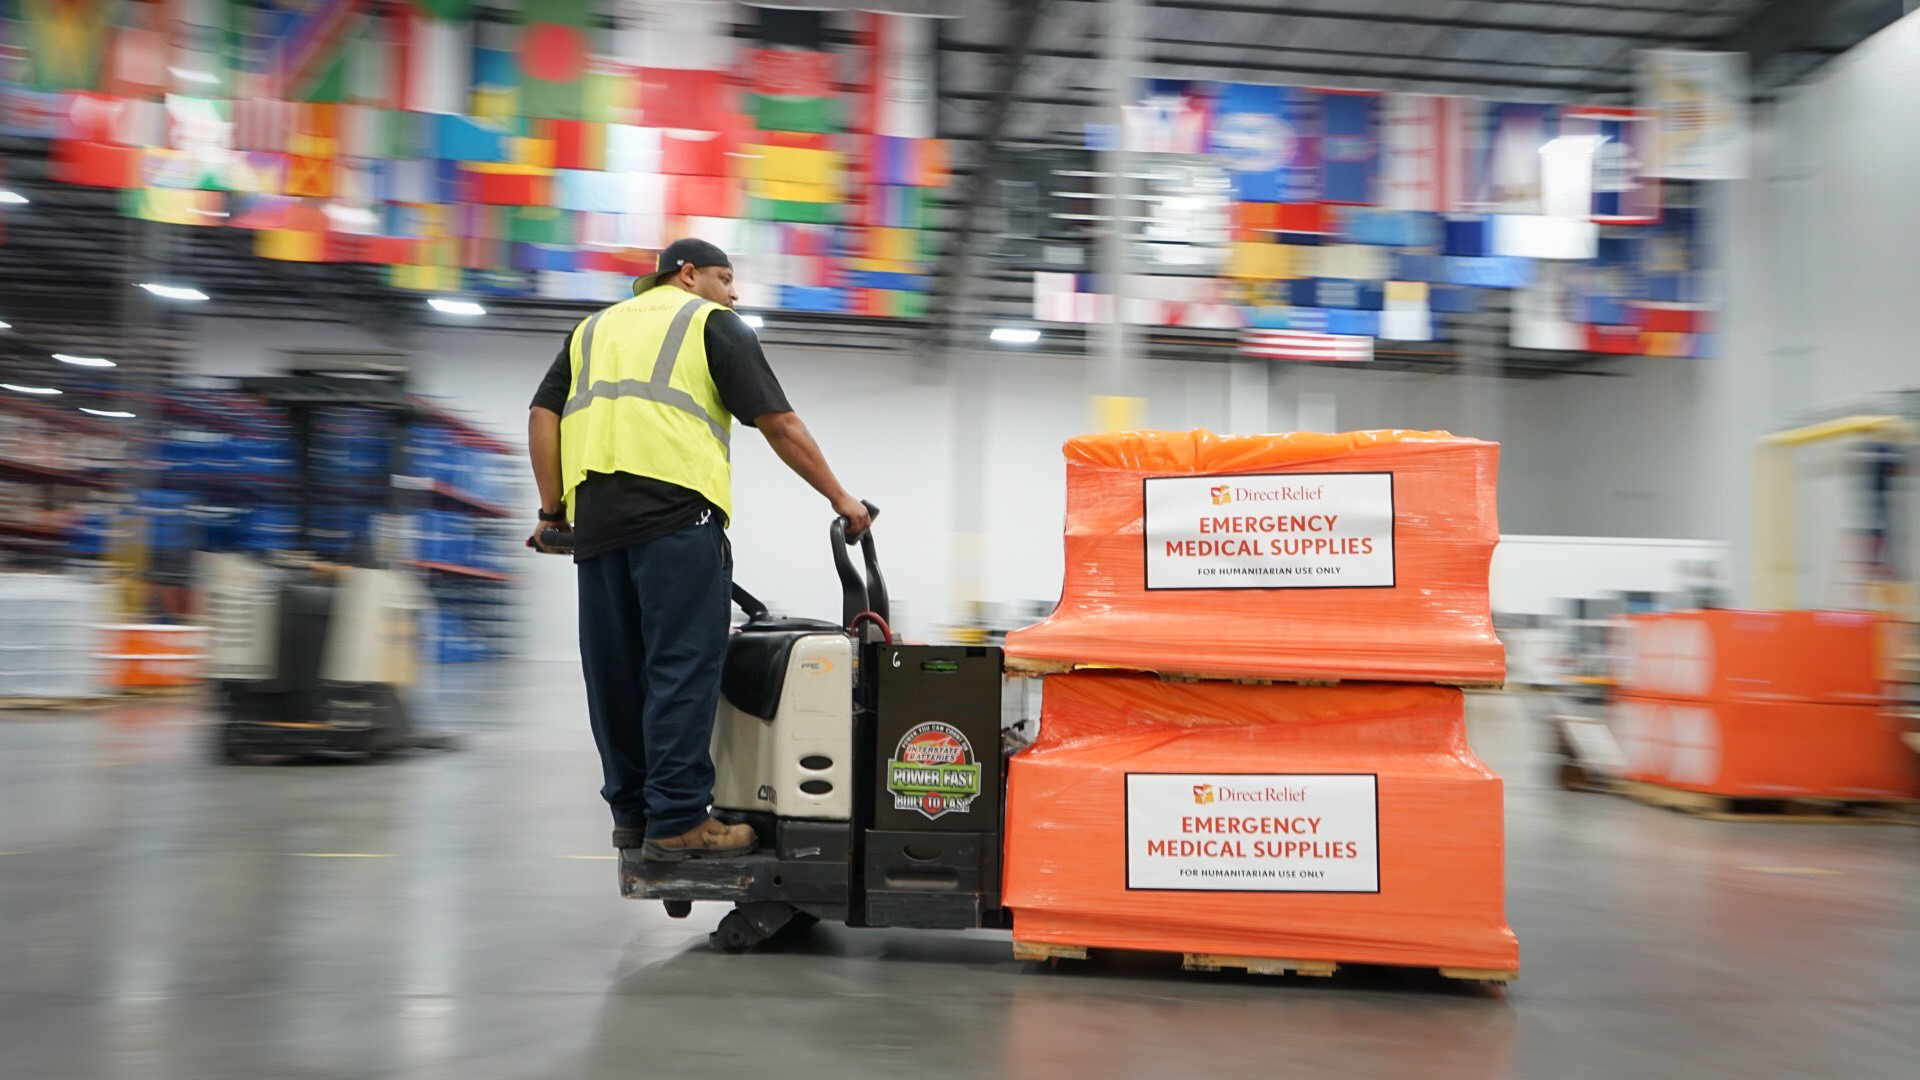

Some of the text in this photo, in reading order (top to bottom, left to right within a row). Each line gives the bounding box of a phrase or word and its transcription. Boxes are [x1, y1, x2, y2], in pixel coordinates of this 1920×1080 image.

[1236, 486, 1323, 502] Direct Relief
[1199, 515, 1338, 534] EMERGENCY
[1166, 537, 1373, 557] MEDICAL SUPPLIES
[1198, 566, 1342, 576] FOR HUMANITARIAN USE ONLY
[893, 768, 975, 788] POWER FAST
[896, 795, 924, 808] BUILT
[927, 796, 940, 809] TO
[1218, 786, 1307, 802] Direct Relief
[1181, 816, 1322, 834] EMERGENCY
[1147, 840, 1358, 859] MEDICAL SUPPLIES
[1179, 869, 1325, 879] FOR HUMANITARIAN USE ONLY
